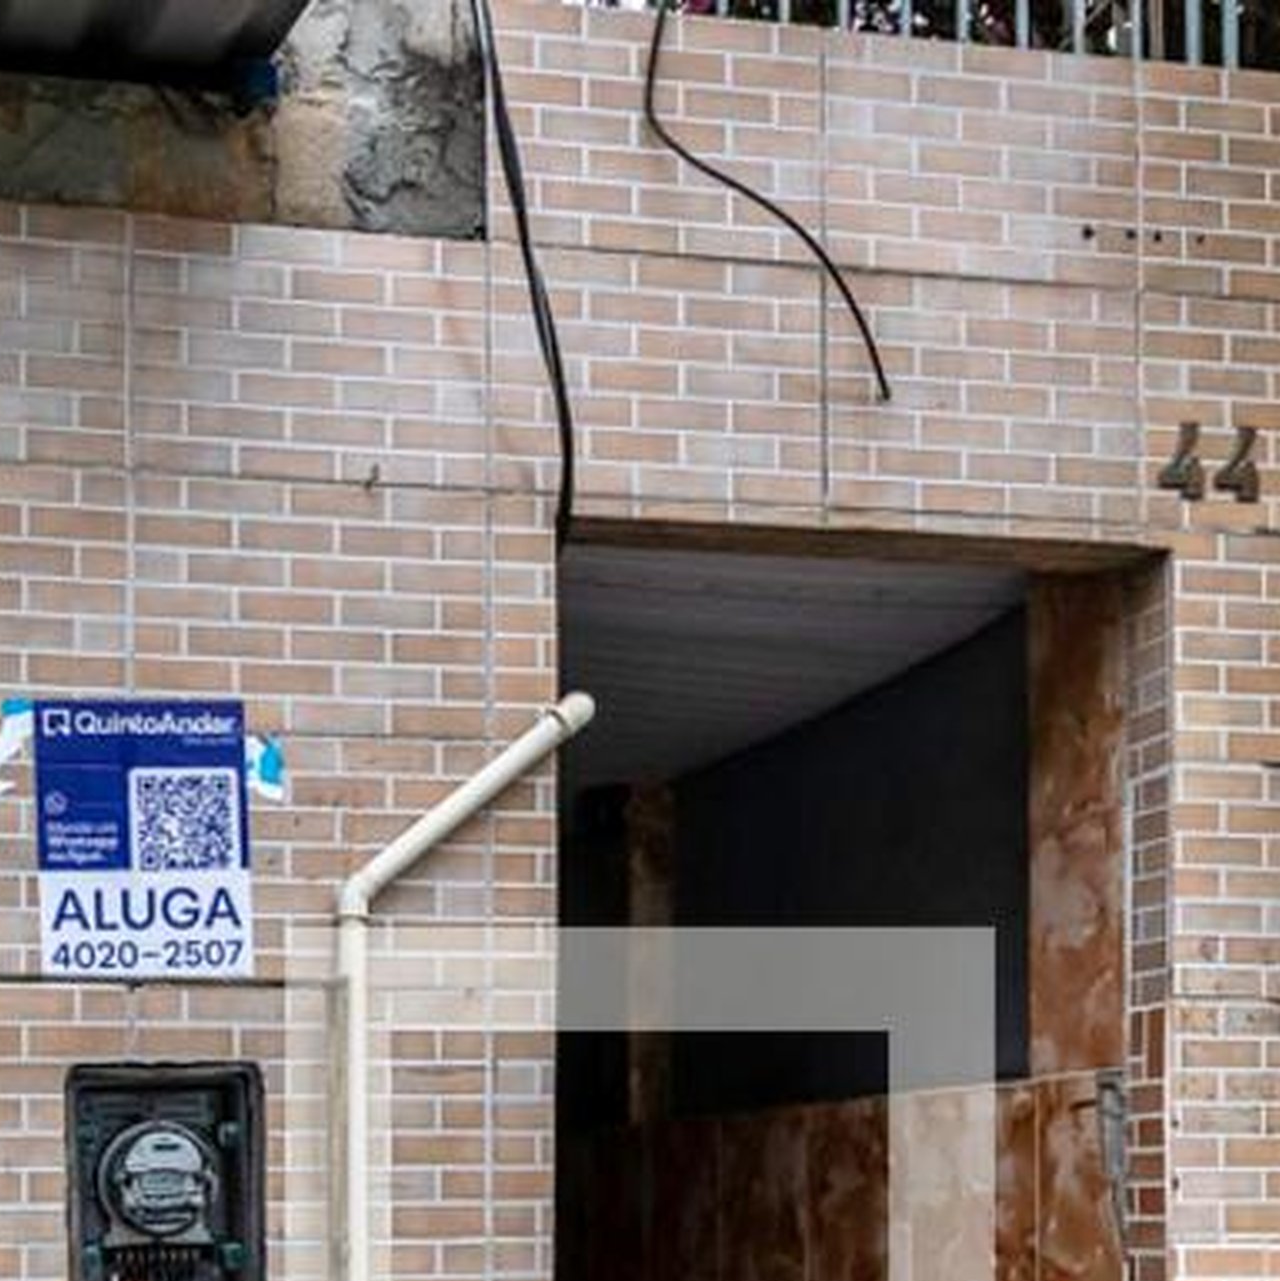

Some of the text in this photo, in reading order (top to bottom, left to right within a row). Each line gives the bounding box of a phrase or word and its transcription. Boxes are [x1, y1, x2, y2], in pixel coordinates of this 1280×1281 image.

[1157, 421, 1261, 502] 44
[74, 710, 236, 736] QuintoAndar
[52, 887, 242, 931] ALUGA
[52, 940, 243, 969] 4020-2507
